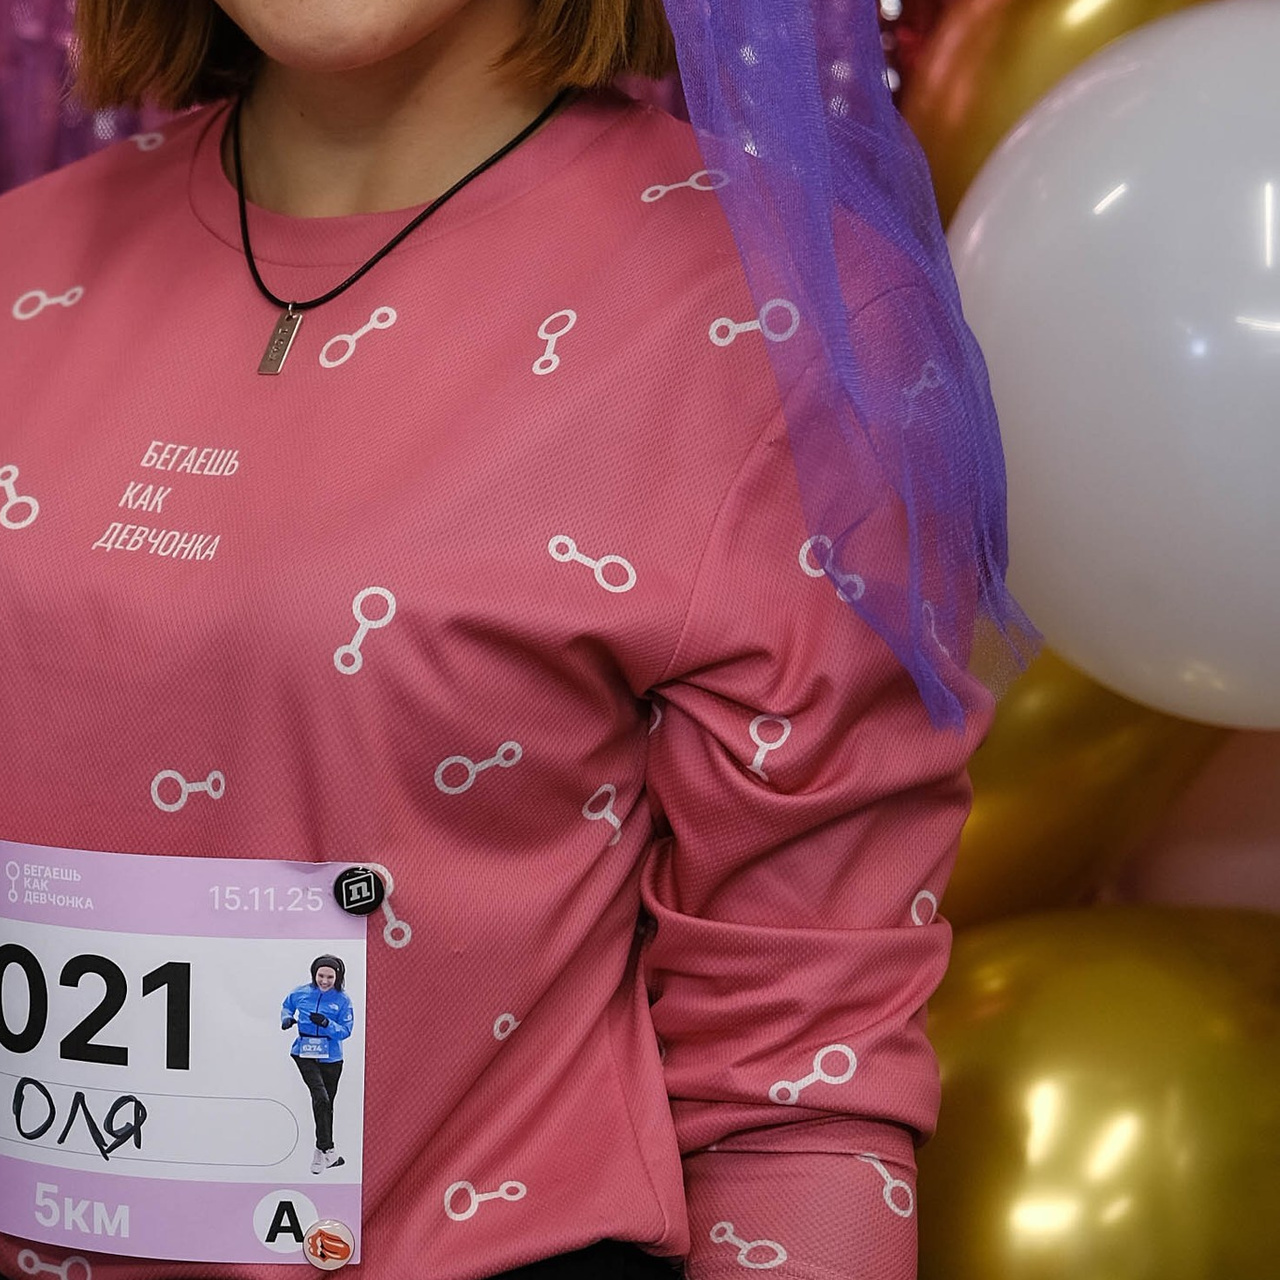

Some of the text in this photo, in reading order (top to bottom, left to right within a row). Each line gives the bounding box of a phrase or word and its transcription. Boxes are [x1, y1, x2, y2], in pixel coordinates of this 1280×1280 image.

[140, 440, 239, 476] БЕГАЕШЬ
[118, 481, 172, 513] КАК
[91, 522, 220, 561] ДЕВЧОНКА
[23, 863, 82, 882] БЕГАЕШЬ
[23, 877, 49, 892] КАК
[23, 890, 94, 910] ДЕВЧОНКА
[209, 885, 324, 912] 15.11.25
